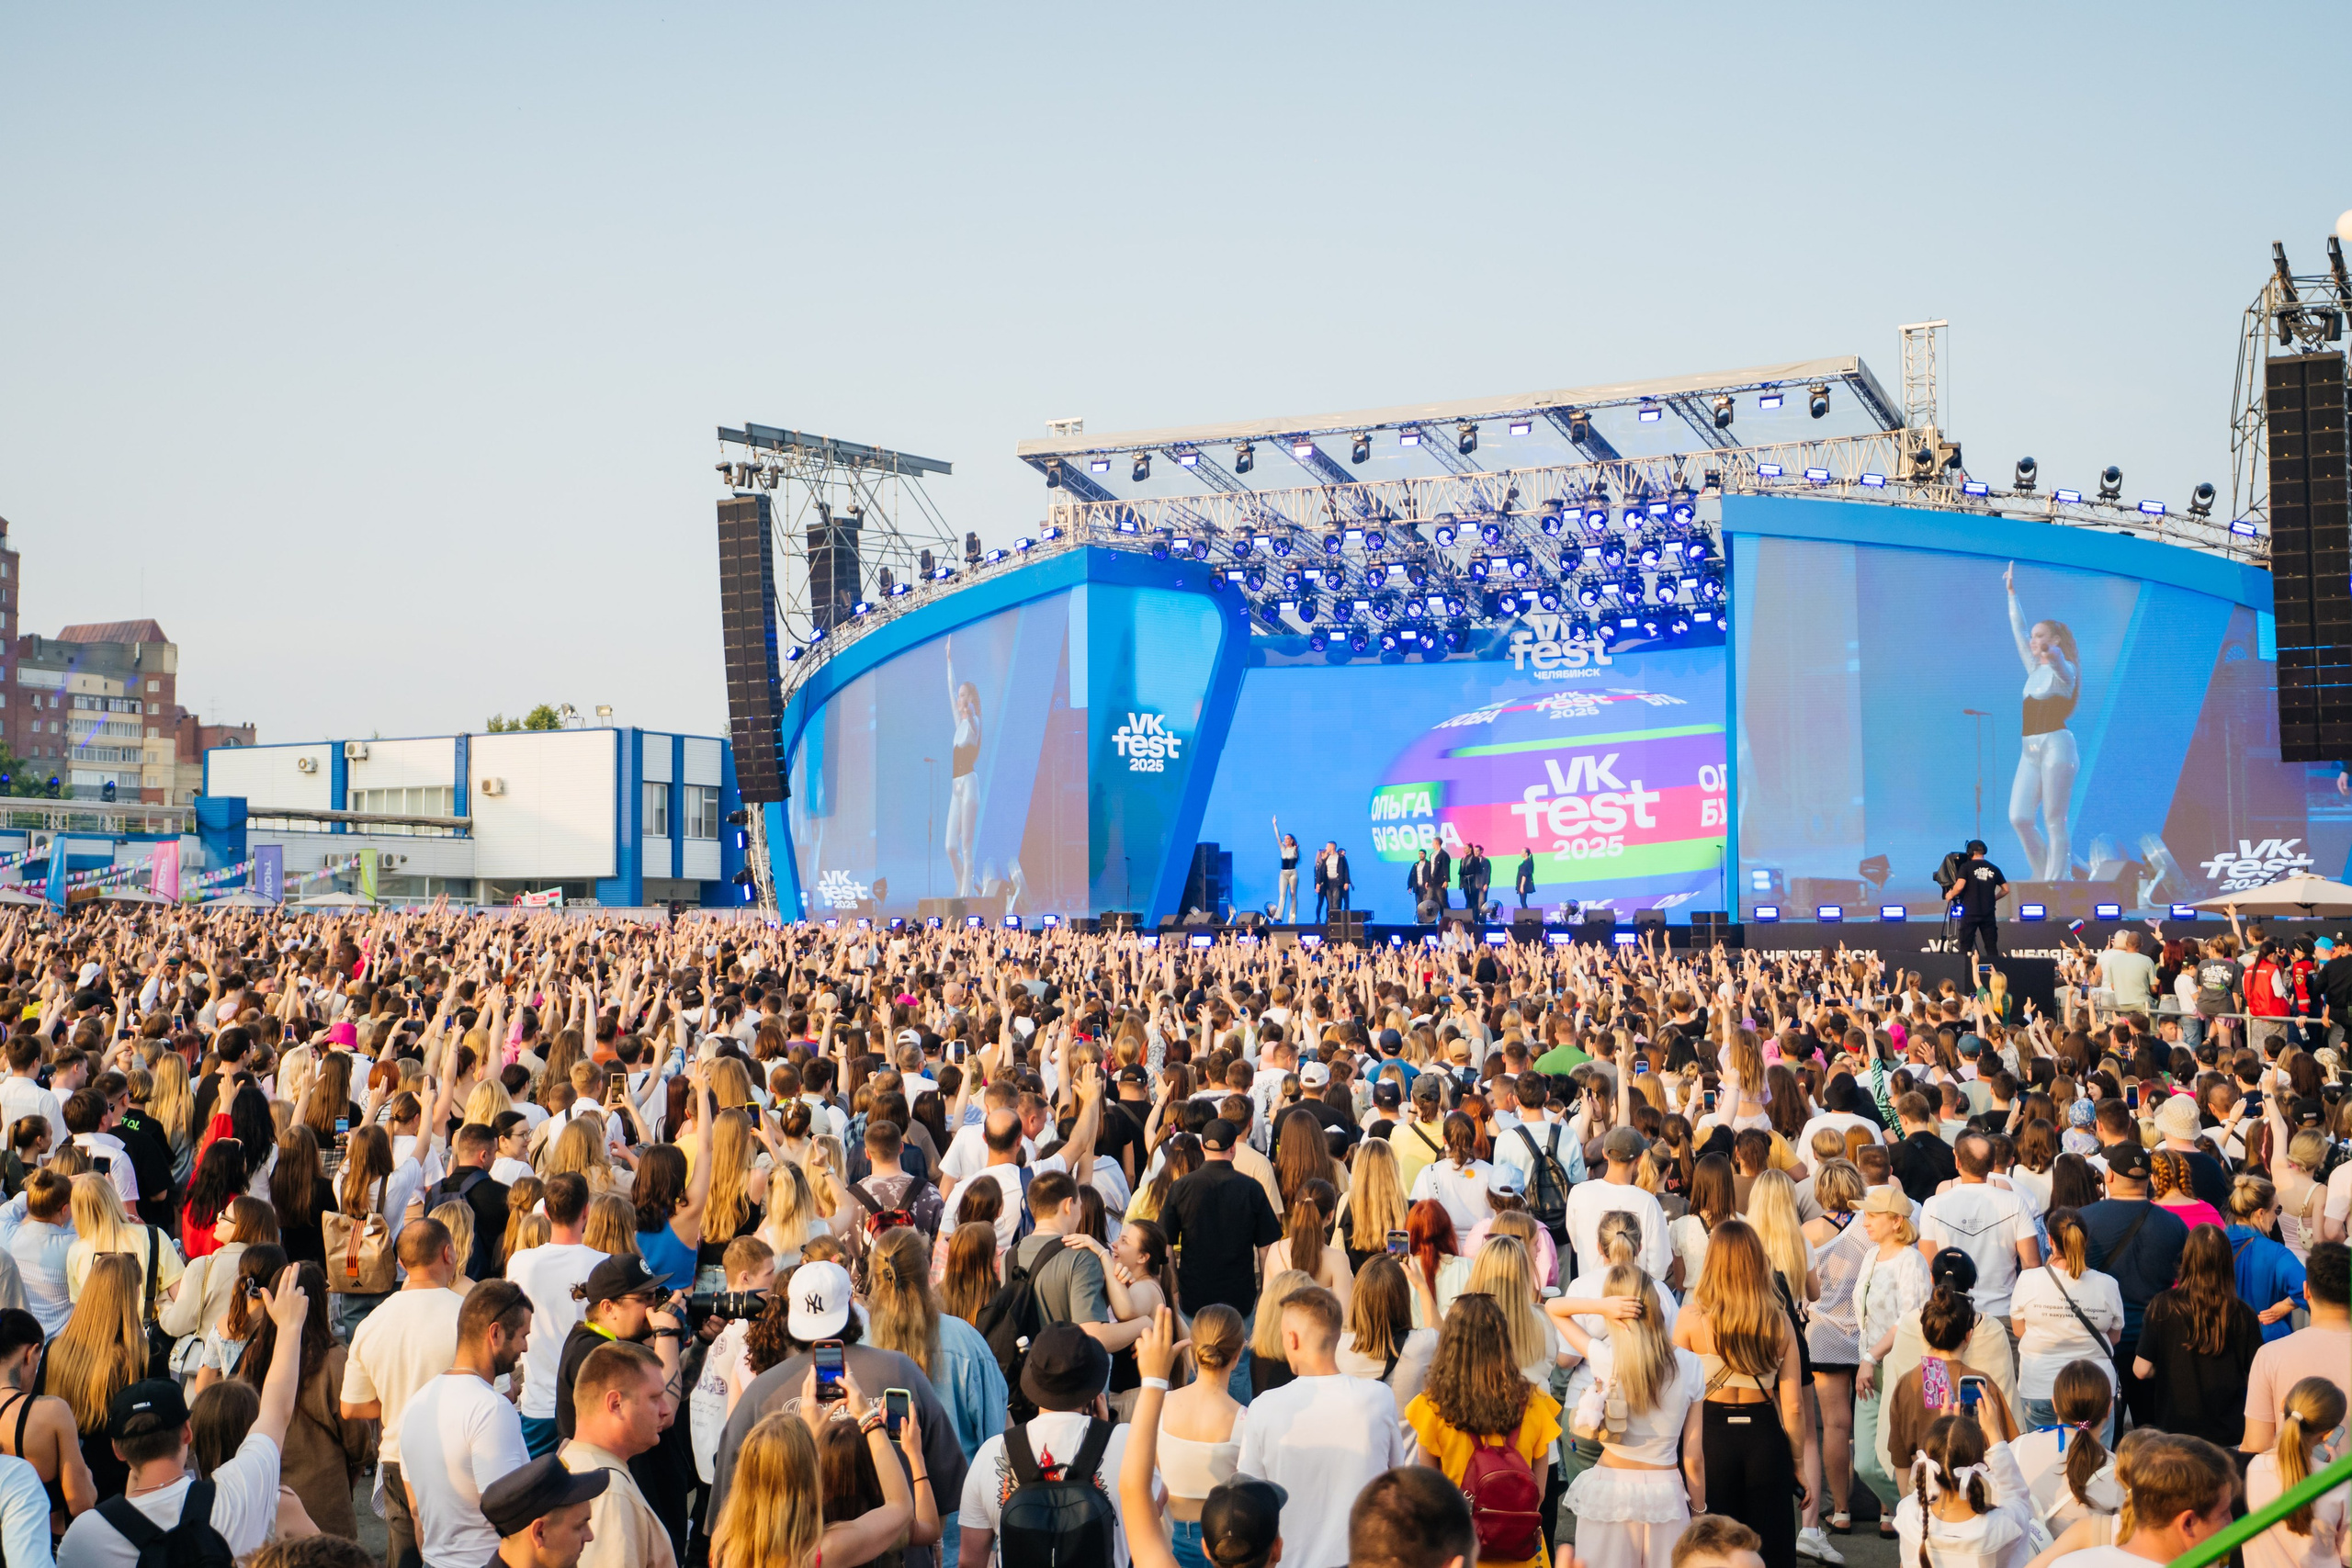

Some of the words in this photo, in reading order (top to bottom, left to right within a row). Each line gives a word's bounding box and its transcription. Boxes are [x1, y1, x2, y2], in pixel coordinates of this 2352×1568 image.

[1510, 630, 1613, 671] fest
[1533, 668, 1600, 680] ЧЕЛЯБИНСК
[1533, 694, 1614, 712] fest
[1549, 706, 1600, 719] 2025
[1127, 712, 1166, 736] VK
[1112, 726, 1182, 759] fest
[1129, 758, 1165, 773] 2025
[1544, 752, 1627, 795] VK
[1371, 791, 1433, 822] ОЛЬГА
[1510, 779, 1660, 839] fest
[1372, 822, 1464, 852] БУЗОВА
[1552, 835, 1625, 862] 2025
[2238, 838, 2301, 859] VK
[2199, 852, 2315, 879] fest
[822, 870, 853, 886] VK
[817, 880, 868, 900] fest
[832, 900, 858, 909] 2025
[805, 1292, 824, 1314] NY
